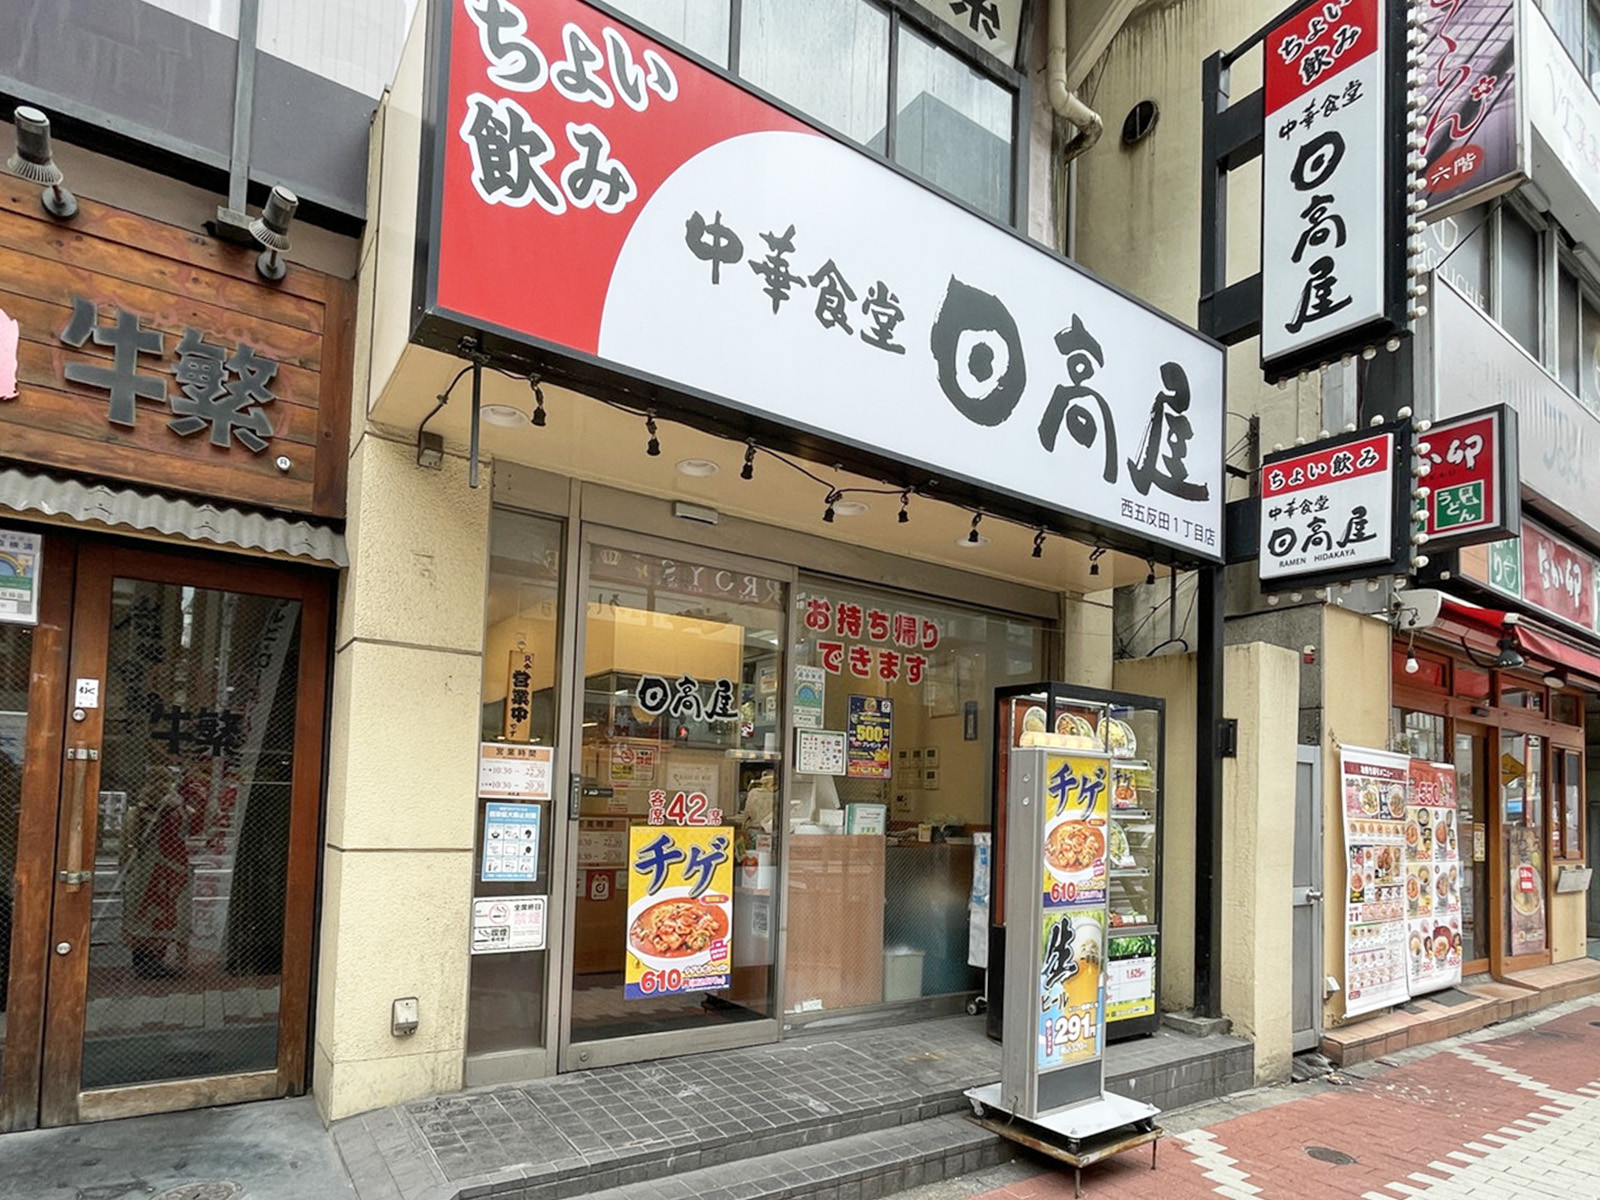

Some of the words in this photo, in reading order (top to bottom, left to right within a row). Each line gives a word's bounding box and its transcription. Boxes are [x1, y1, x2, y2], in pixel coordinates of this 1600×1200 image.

[1298, 24, 1362, 85] 飲み
[1278, 79, 1363, 141] 中華食堂
[459, 92, 638, 215] 飲み
[1431, 150, 1477, 186] 六階
[1284, 131, 1353, 334] 日高屋
[60, 295, 278, 453] 牛繁
[685, 209, 906, 355] 中華食堂
[930, 273, 1211, 502] 日高屋
[1269, 446, 1380, 491] ちょい飲み
[1267, 505, 1378, 558] 日高屋
[1268, 494, 1330, 521] 中華食堂
[1437, 491, 1476, 523] うどん
[1278, 556, 1307, 568] RAMEN
[1314, 548, 1356, 562] HIDAKAYA
[804, 595, 940, 650] お持ち帰り
[816, 639, 929, 685] できます
[635, 673, 740, 722] 日高屋
[648, 789, 666, 825] 客席
[1048, 761, 1107, 822] チゲ
[634, 832, 730, 898] チゲ
[1041, 913, 1079, 990] 生
